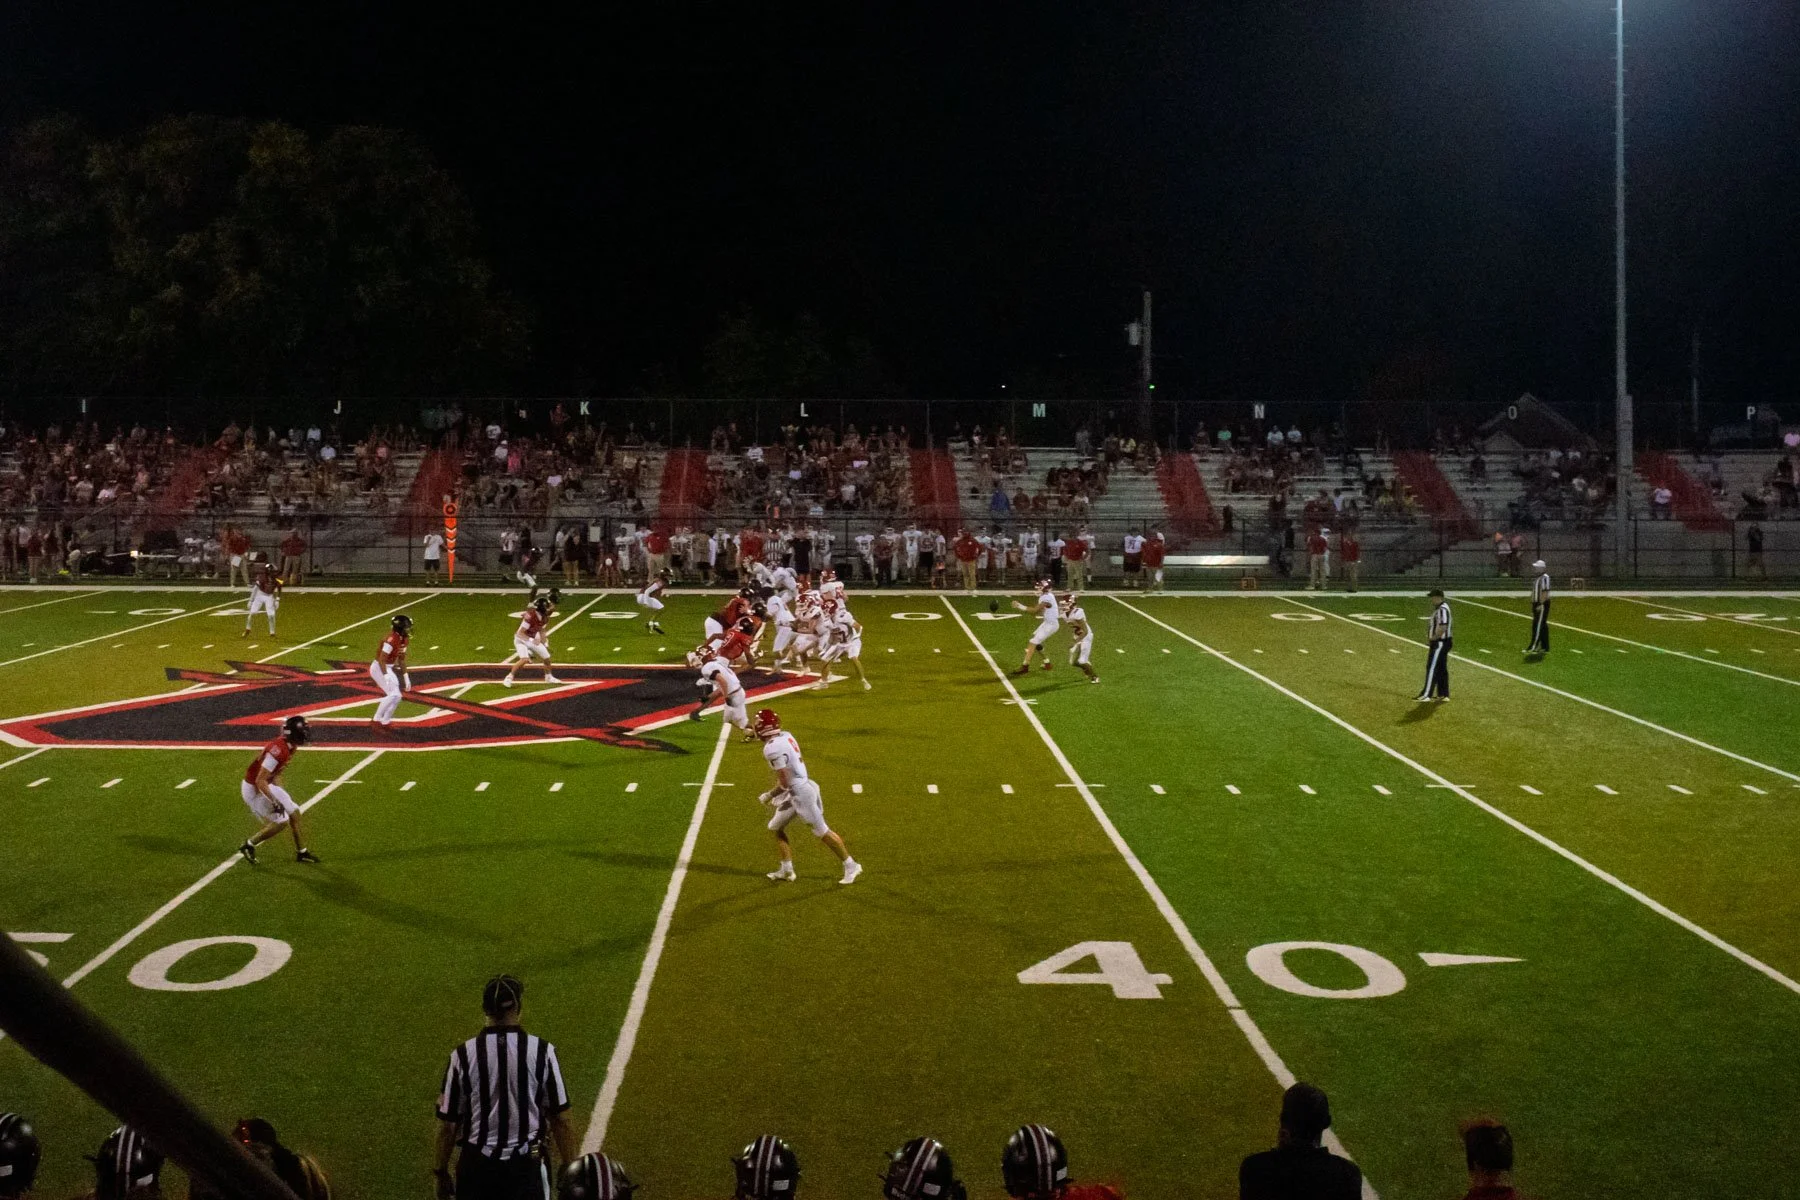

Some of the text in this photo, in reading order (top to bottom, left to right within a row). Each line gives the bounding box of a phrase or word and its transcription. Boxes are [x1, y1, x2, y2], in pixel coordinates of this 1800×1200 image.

[332, 400, 343, 415] J
[579, 401, 591, 416] K
[799, 402, 810, 417] L
[1032, 403, 1047, 418] M
[1254, 404, 1266, 419] N
[1746, 405, 1756, 420] P
